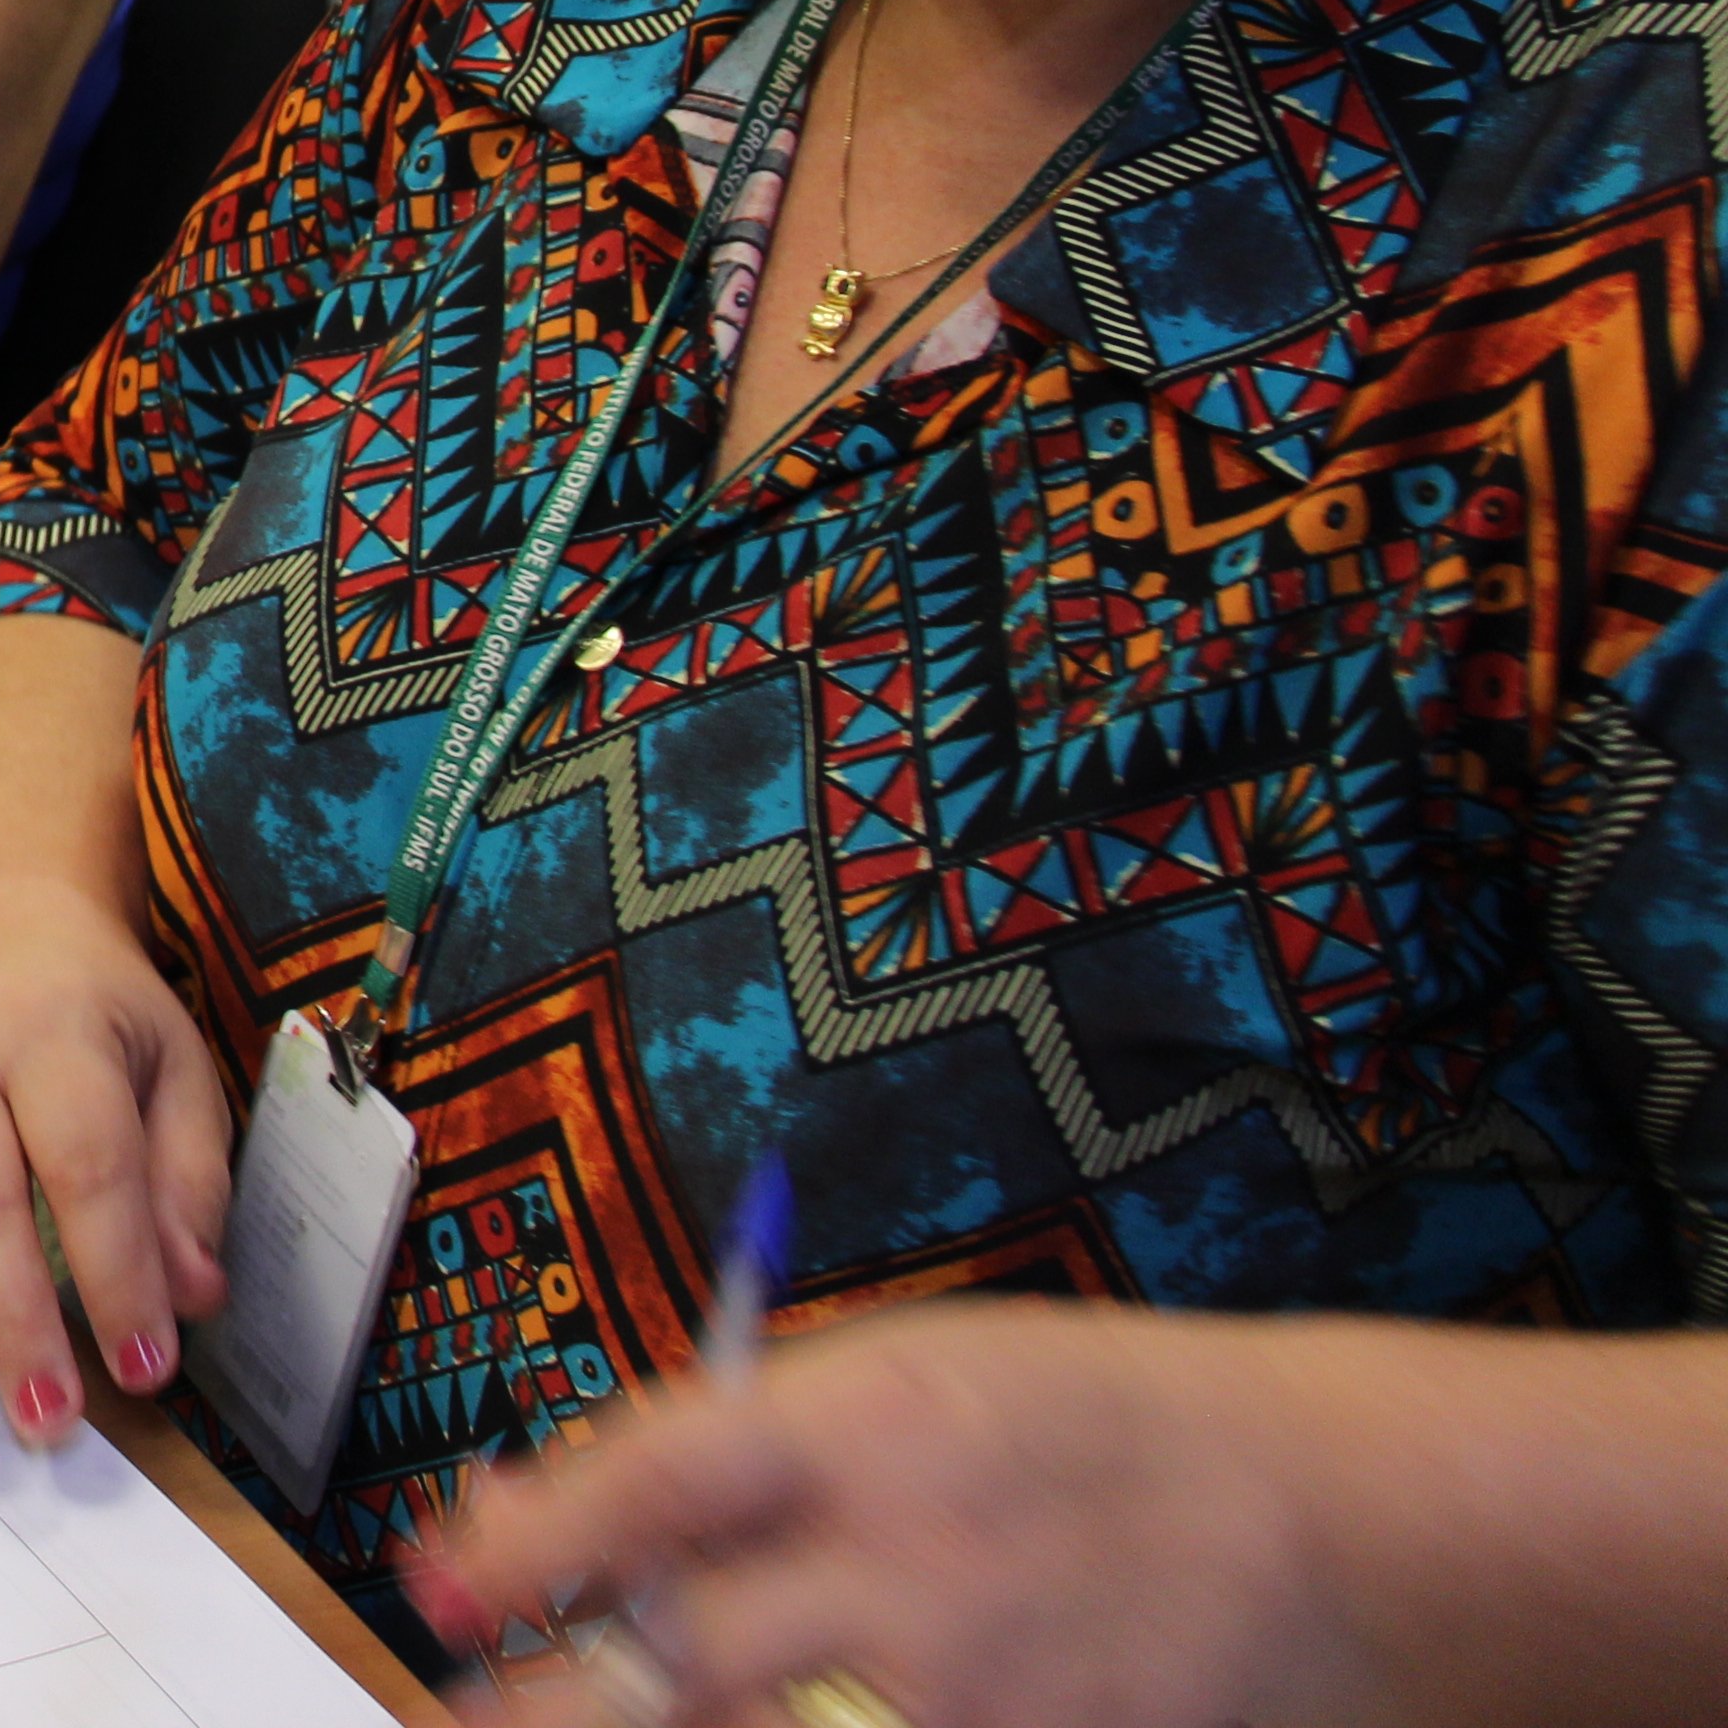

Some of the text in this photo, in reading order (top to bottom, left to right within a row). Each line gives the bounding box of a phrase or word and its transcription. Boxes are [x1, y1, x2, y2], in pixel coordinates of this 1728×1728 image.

[793, 31, 818, 59] DE
[757, 55, 804, 120] MATO
[719, 118, 771, 202] GROSSO
[537, 450, 600, 539] FEDERAL
[527, 538, 556, 569] DE
[493, 562, 543, 634] MATO
[456, 630, 516, 732] GROSSO
[443, 722, 476, 759] DO
[469, 745, 497, 778] DE
[487, 684, 532, 749] MATO
[424, 758, 460, 799] SUL
[401, 814, 438, 873] IFMS
